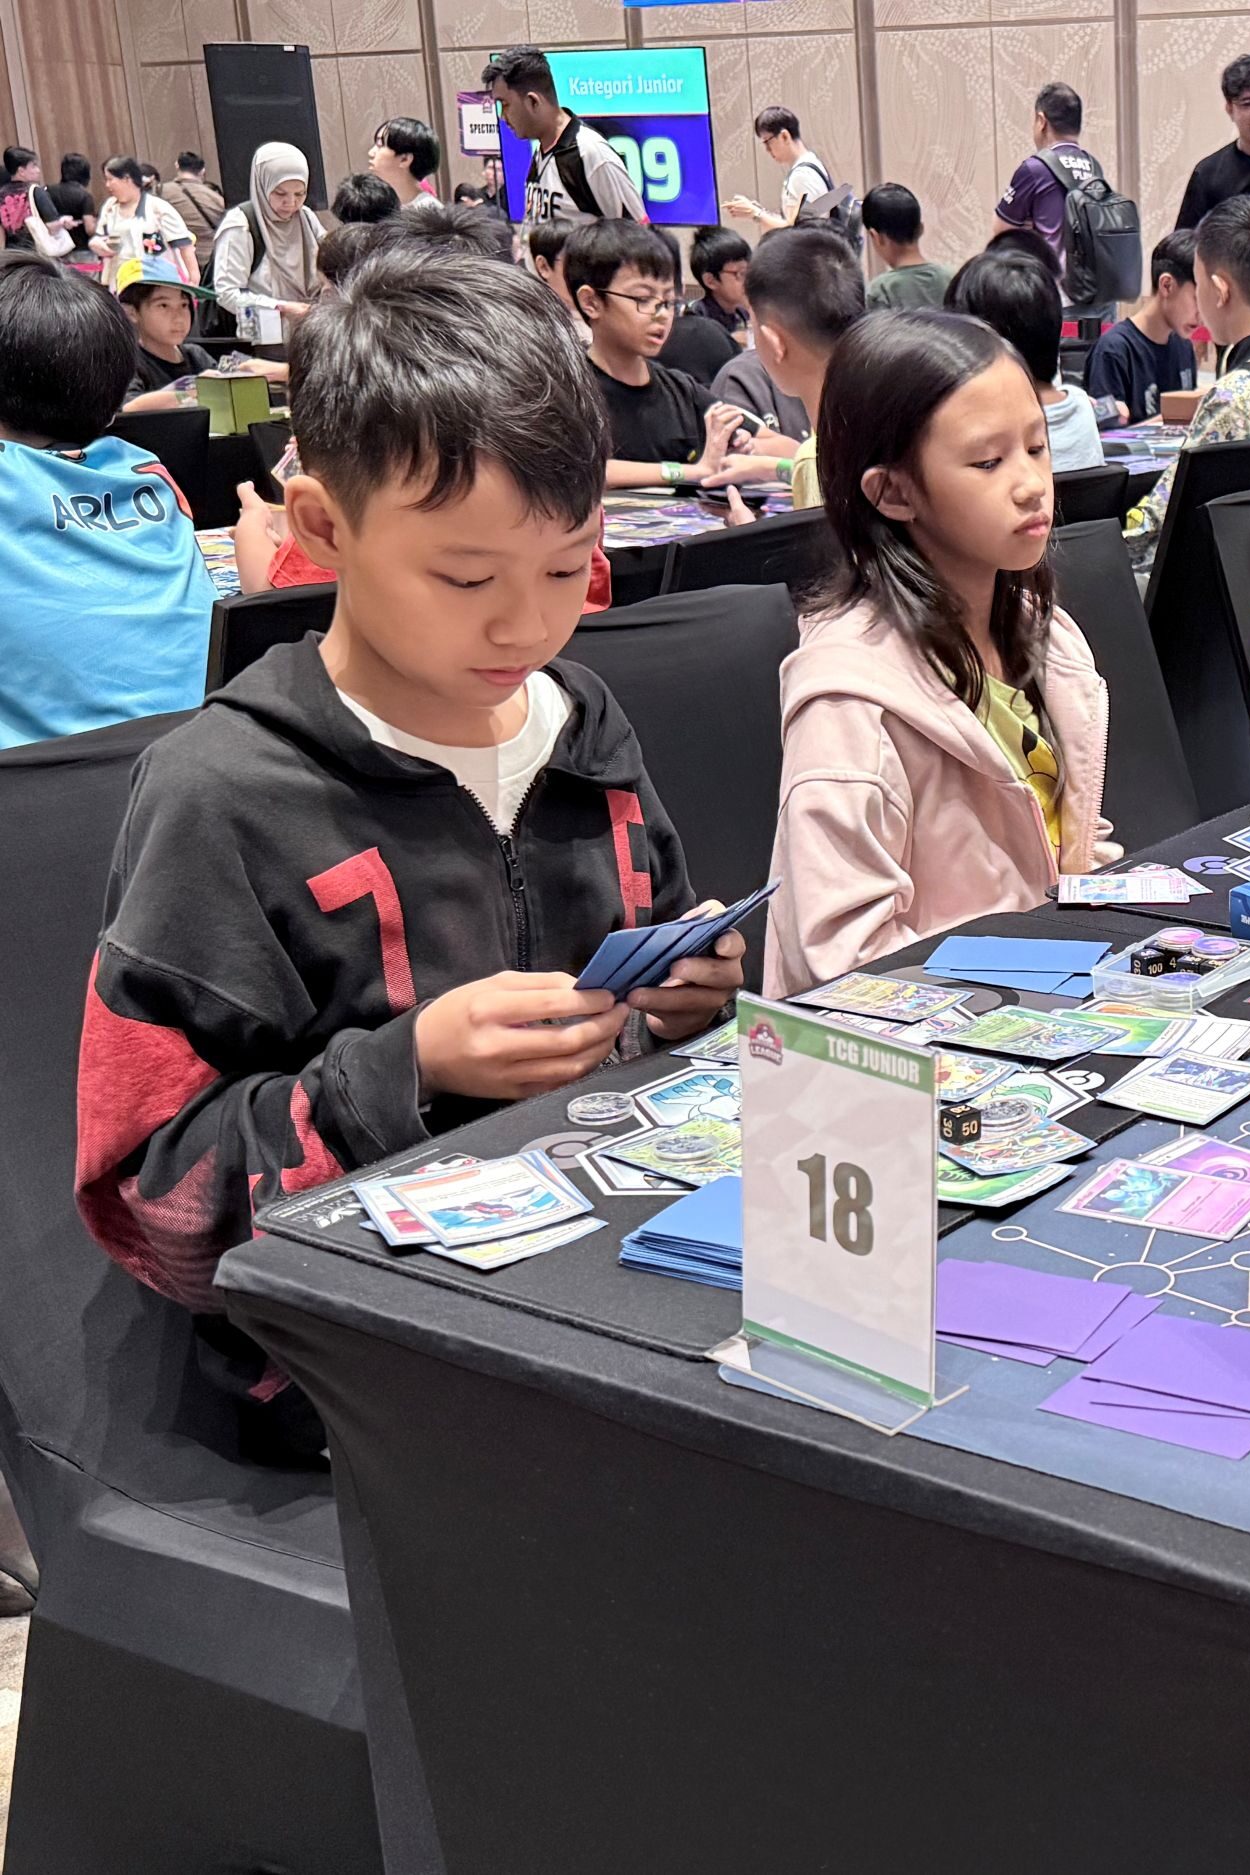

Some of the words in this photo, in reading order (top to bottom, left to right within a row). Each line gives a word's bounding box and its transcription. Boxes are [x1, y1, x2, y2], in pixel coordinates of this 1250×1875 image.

[568, 76, 633, 99] Kategori
[637, 73, 684, 94] Junior
[52, 485, 166, 531] ARLO
[1147, 962, 1163, 975] 100
[825, 1034, 859, 1067] TCG
[861, 1045, 920, 1085] JUNIOR
[943, 1118, 953, 1138] 30
[962, 1120, 978, 1136] 50
[797, 1153, 874, 1257] 18
